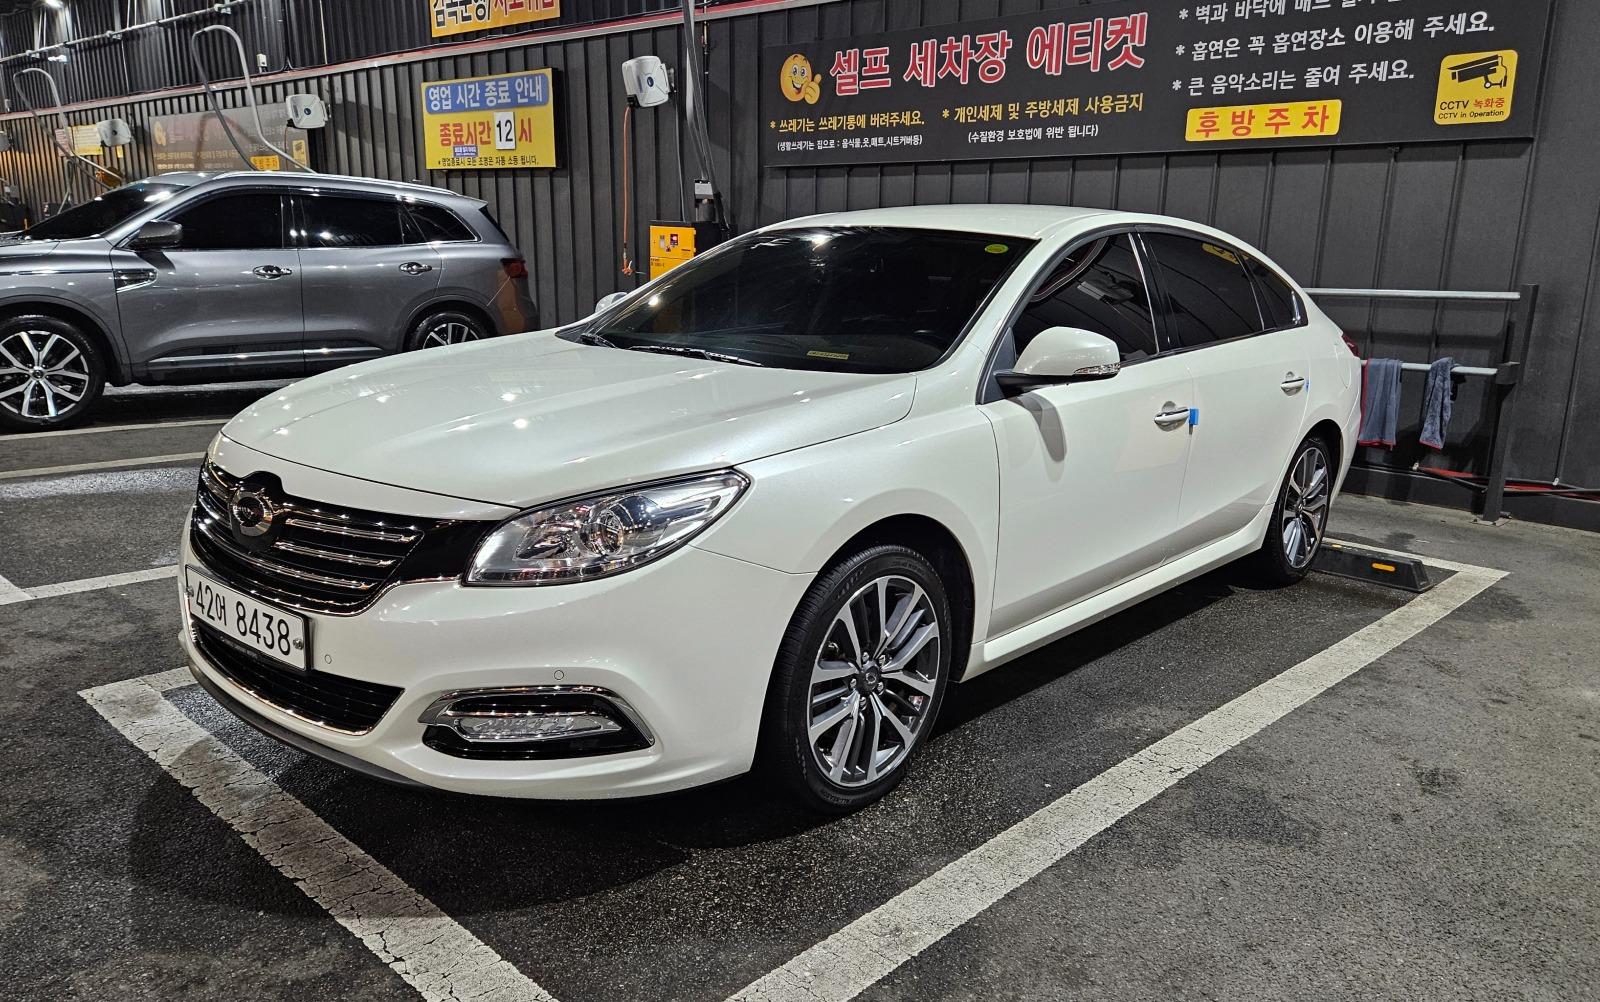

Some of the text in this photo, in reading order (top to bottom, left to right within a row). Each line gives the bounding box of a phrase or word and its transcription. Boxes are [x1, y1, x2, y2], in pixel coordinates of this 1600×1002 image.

[1195, 4, 1229, 24] 벽과
[1234, 0, 1286, 20] 바닥에
[1191, 10, 1495, 61] 흡연은 꼭 흡연장소 이용해 주세요.
[829, 12, 1149, 97] 셀프 세차장 에티켓
[428, 75, 543, 111] 영업 시간 종료 안내
[1187, 59, 1415, 97] 큰 음악소리는 줄여 주세요.
[953, 92, 1144, 123] 개인세제 및 주방세제 사용금지
[1438, 112, 1458, 120] CCTV
[1469, 110, 1504, 118] Operation
[1439, 97, 1505, 110] CCTV 녹화중
[439, 117, 533, 147] 종료시간 12 시
[778, 110, 925, 133] 쓰레기는 쓰레기통에 버려주세요.
[967, 124, 1099, 143] (수질환경 보호법에 위반 됩니다)
[817, 139, 835, 150] 집으로
[236, 600, 291, 656] 8438
